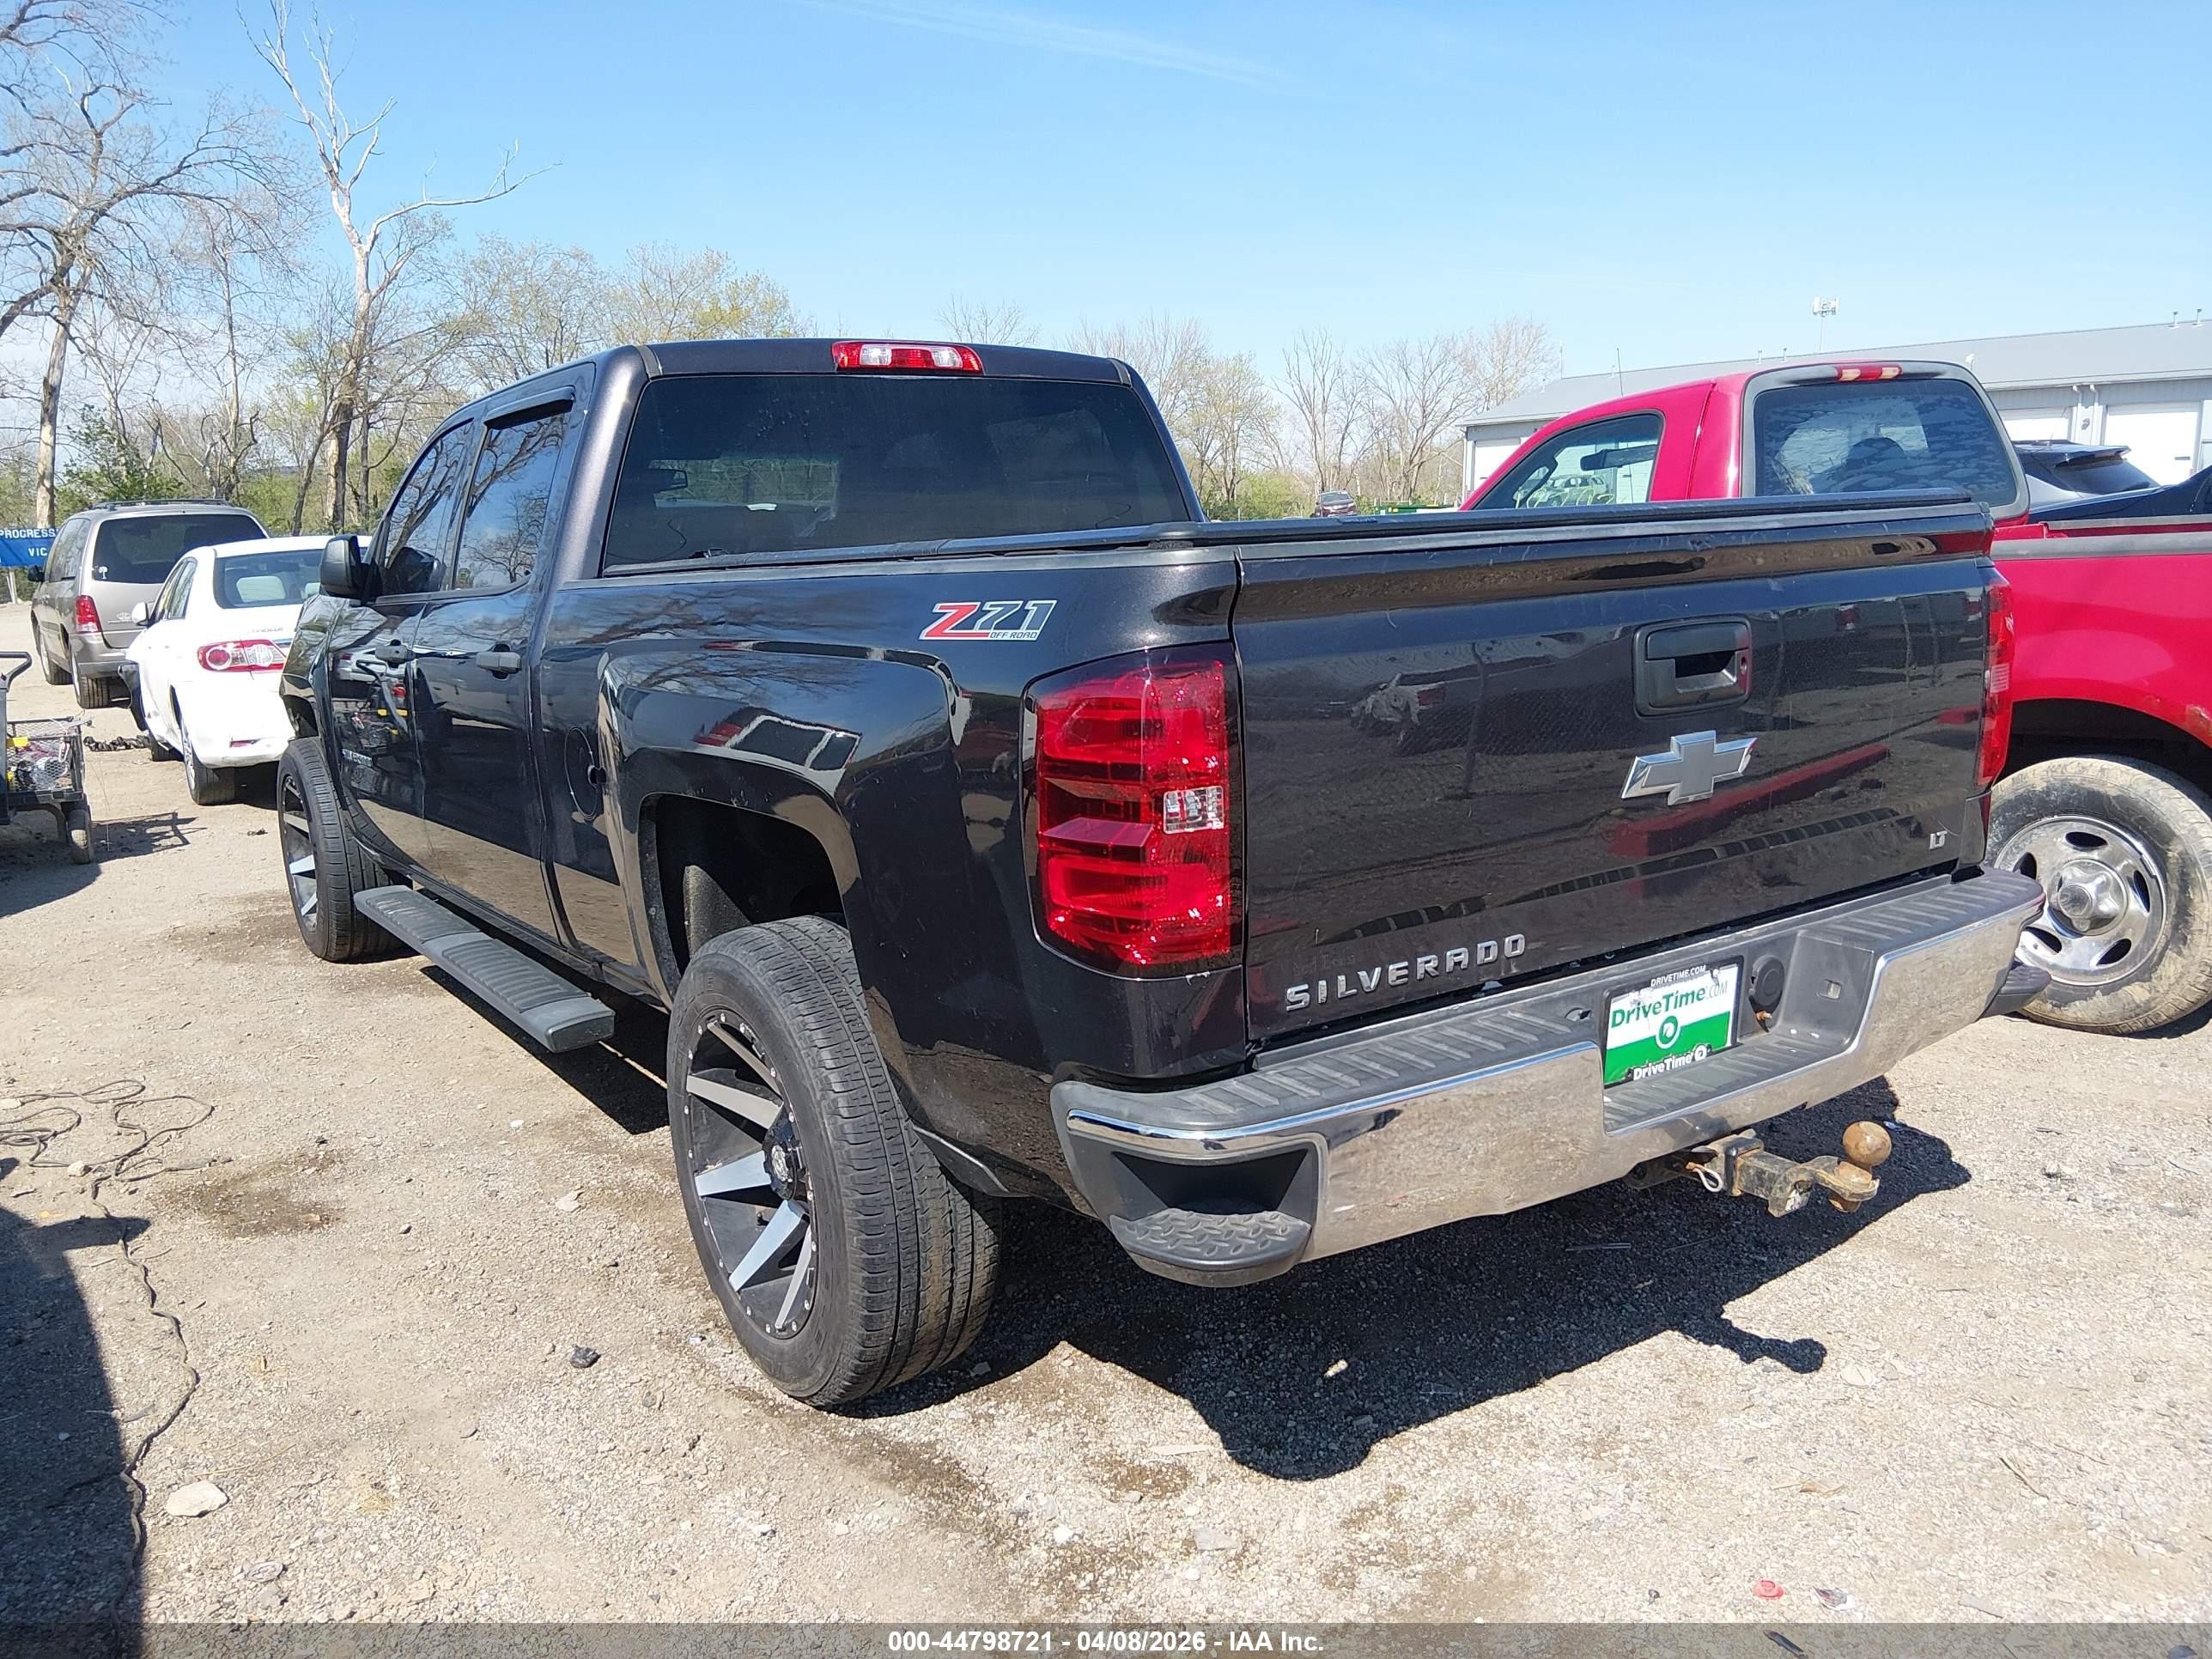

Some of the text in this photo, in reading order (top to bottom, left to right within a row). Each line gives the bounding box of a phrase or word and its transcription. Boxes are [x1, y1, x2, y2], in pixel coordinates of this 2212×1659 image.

[918, 600, 1058, 641] Z71
[1929, 830, 1948, 849] LT
[1285, 933, 1526, 1012] SILVERADO
[1650, 965, 1707, 988] DRIVETIME.COM
